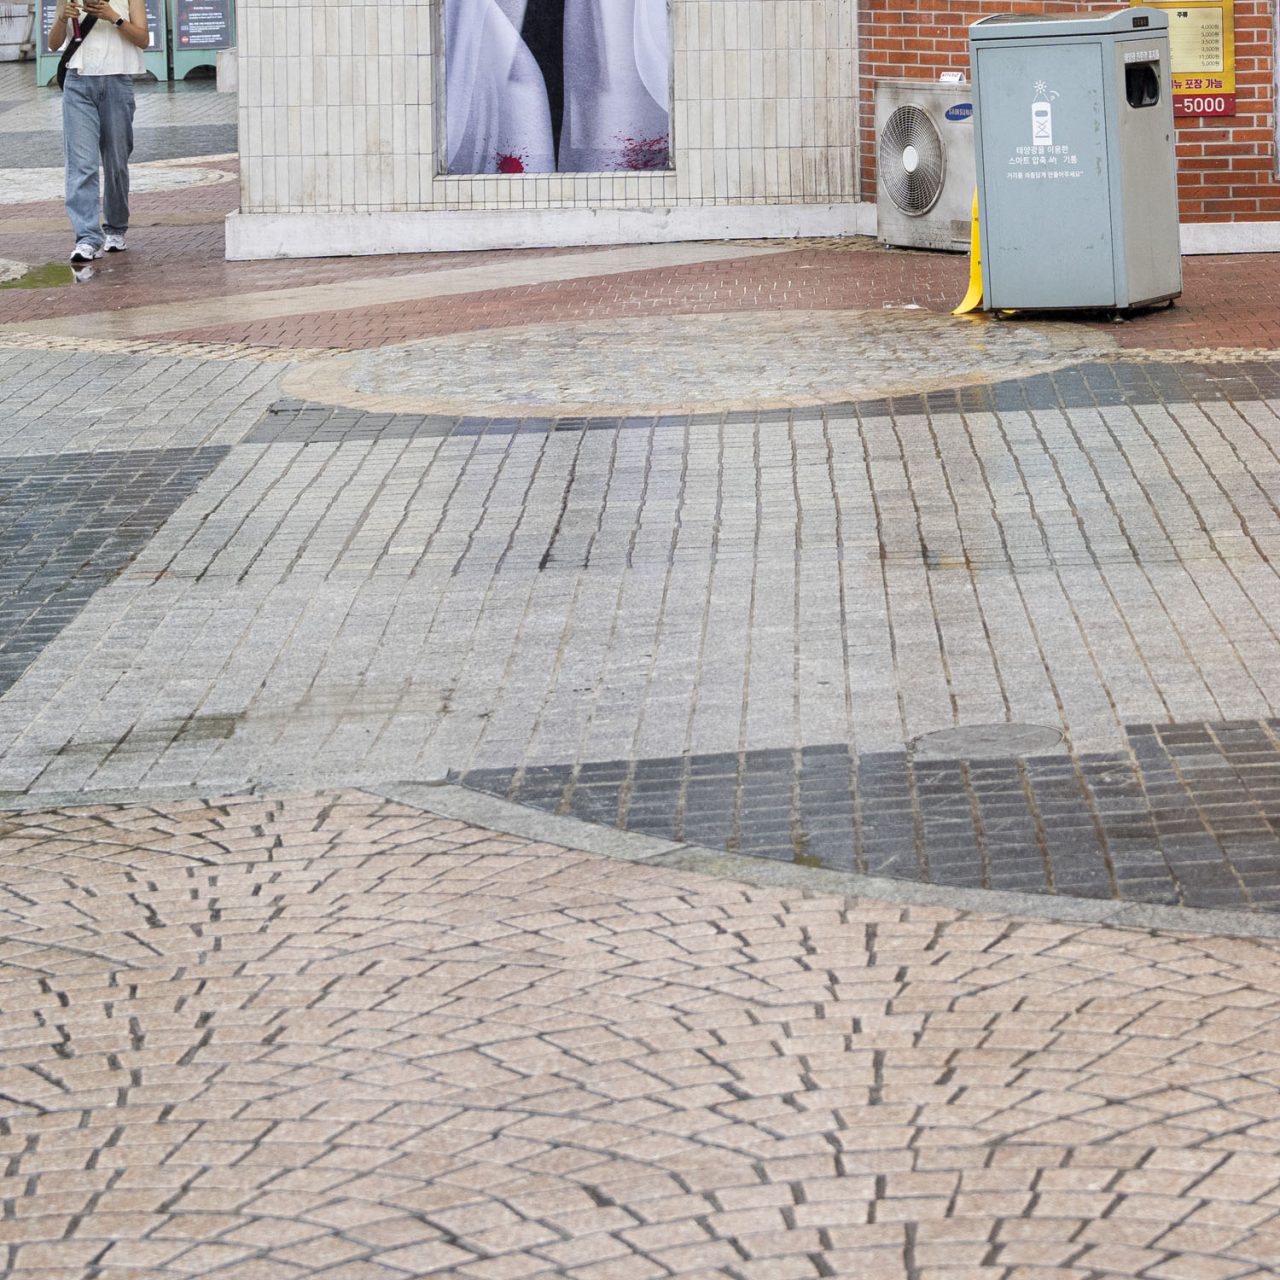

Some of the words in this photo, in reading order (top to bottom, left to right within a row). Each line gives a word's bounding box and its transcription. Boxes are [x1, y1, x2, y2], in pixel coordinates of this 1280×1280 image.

[1172, 80, 1182, 89] 뉴
[1185, 79, 1203, 89] 포장
[1206, 78, 1222, 89] 가능
